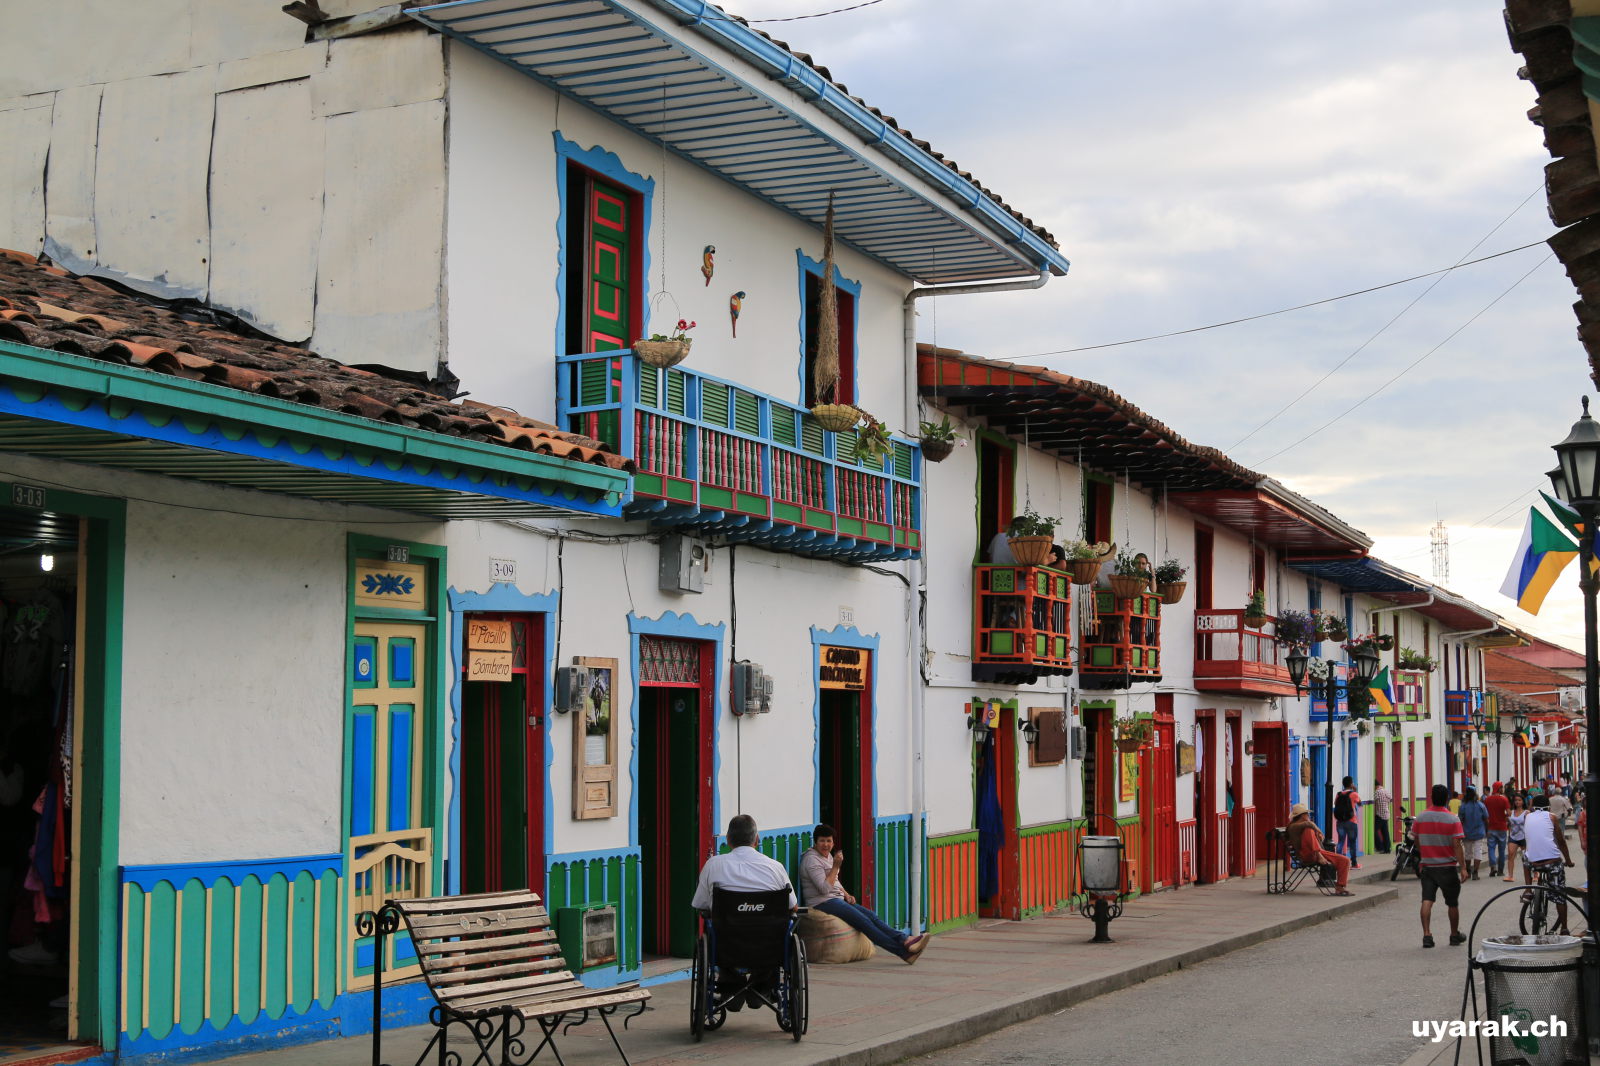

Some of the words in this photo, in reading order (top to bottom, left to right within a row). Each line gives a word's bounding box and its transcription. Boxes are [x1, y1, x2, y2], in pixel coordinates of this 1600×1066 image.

[16, 487, 42, 506] 3-03
[390, 547, 407, 562] 3-05
[494, 562, 514, 577] 3-09
[470, 624, 478, 635] El
[737, 902, 765, 912] drive
